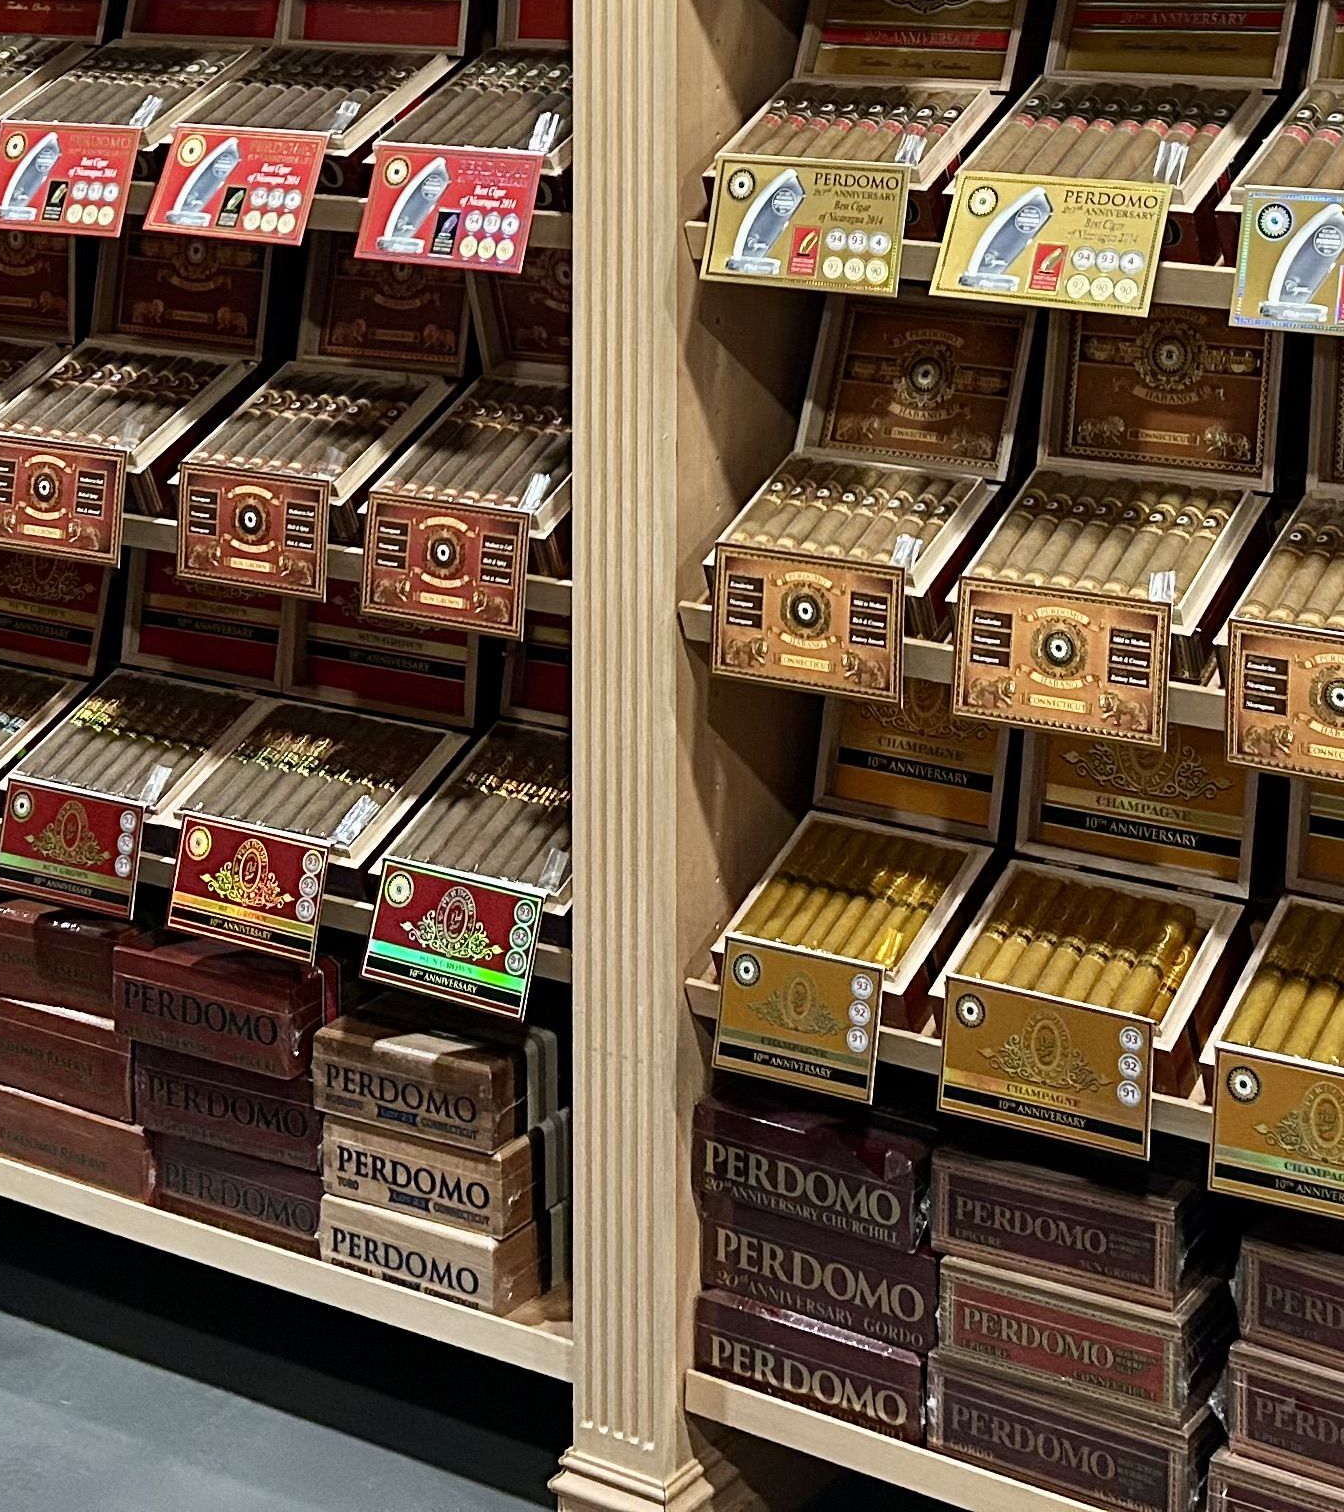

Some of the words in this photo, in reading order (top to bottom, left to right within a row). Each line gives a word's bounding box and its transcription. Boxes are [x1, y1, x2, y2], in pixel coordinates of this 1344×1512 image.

[814, 171, 900, 191] PERDOMO
[1064, 190, 1158, 210] PERDOMO
[830, 235, 843, 245] 94
[851, 236, 864, 247] 93
[1077, 252, 1092, 264] 94
[1100, 254, 1115, 267] 93
[1040, 672, 1083, 688] HABANO
[1028, 695, 1087, 714] CONNECTICUT
[878, 734, 964, 762] CHAMPAGNE
[889, 758, 970, 787] ANNIVERSARY
[1096, 794, 1192, 822] CHAMPAGNE
[1110, 819, 1200, 848] ANNIVERSARY
[223, 922, 273, 940] ANNIVERSARY
[424, 972, 478, 995] ANNIVERSARY
[855, 979, 870, 993] 93
[123, 980, 279, 1047] PERDOMO
[853, 1006, 867, 1020] 92
[851, 1032, 864, 1045] 91
[1125, 1033, 1139, 1046] 93
[772, 1056, 834, 1079] ANNIVERSARY
[1123, 1060, 1137, 1073] 92
[326, 1063, 478, 1124] PERDOMO
[1007, 1082, 1081, 1109] CHAMPAGNE
[1122, 1086, 1136, 1100] 91
[148, 1075, 309, 1140] PERDOMO
[1018, 1103, 1087, 1128] ANNIVERSARY
[337, 1144, 491, 1210] PERDOMO
[704, 1138, 900, 1226] PERDOMO
[165, 1161, 316, 1233] PERDOMO
[956, 1197, 1108, 1258] PERDOMO
[331, 1226, 480, 1296] PERDOMO
[714, 1226, 926, 1324] PERDOMO
[863, 1318, 924, 1348] GORDO
[963, 1306, 1114, 1372] PERDOMO
[710, 1334, 909, 1428] PERDOMO
[952, 1404, 1118, 1482] PERDOMO
